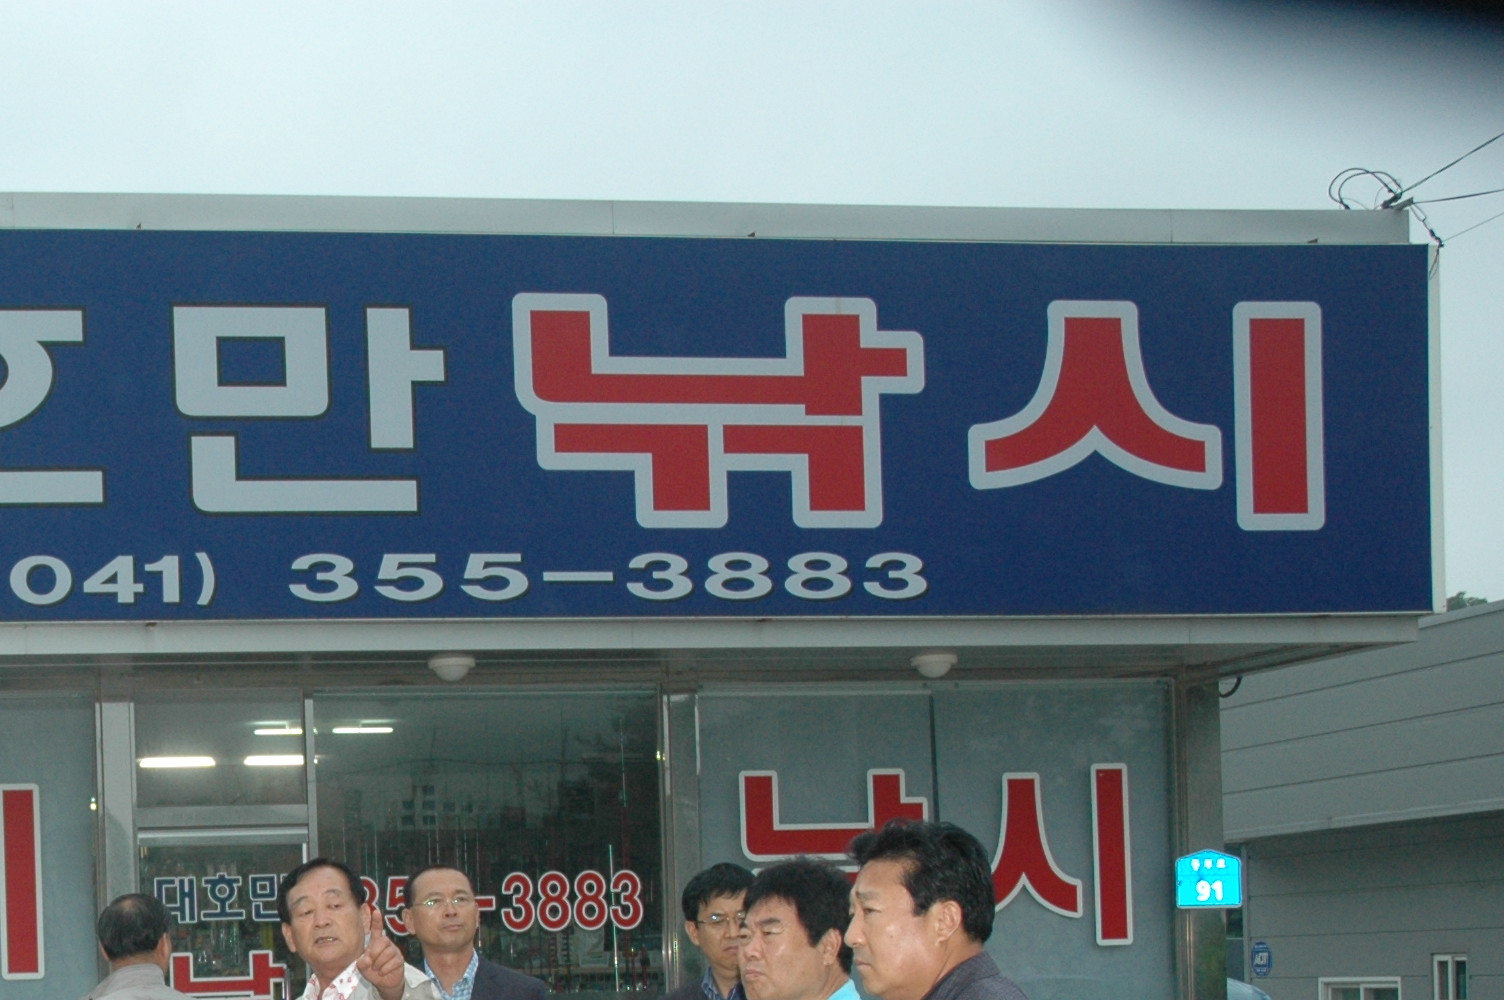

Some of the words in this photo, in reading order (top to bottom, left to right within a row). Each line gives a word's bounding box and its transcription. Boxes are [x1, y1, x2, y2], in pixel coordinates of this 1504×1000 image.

[512, 292, 1326, 531] 낚시
[8, 551, 218, 606] 041)
[287, 550, 929, 604] 355-3883
[1196, 879, 1224, 902] 91
